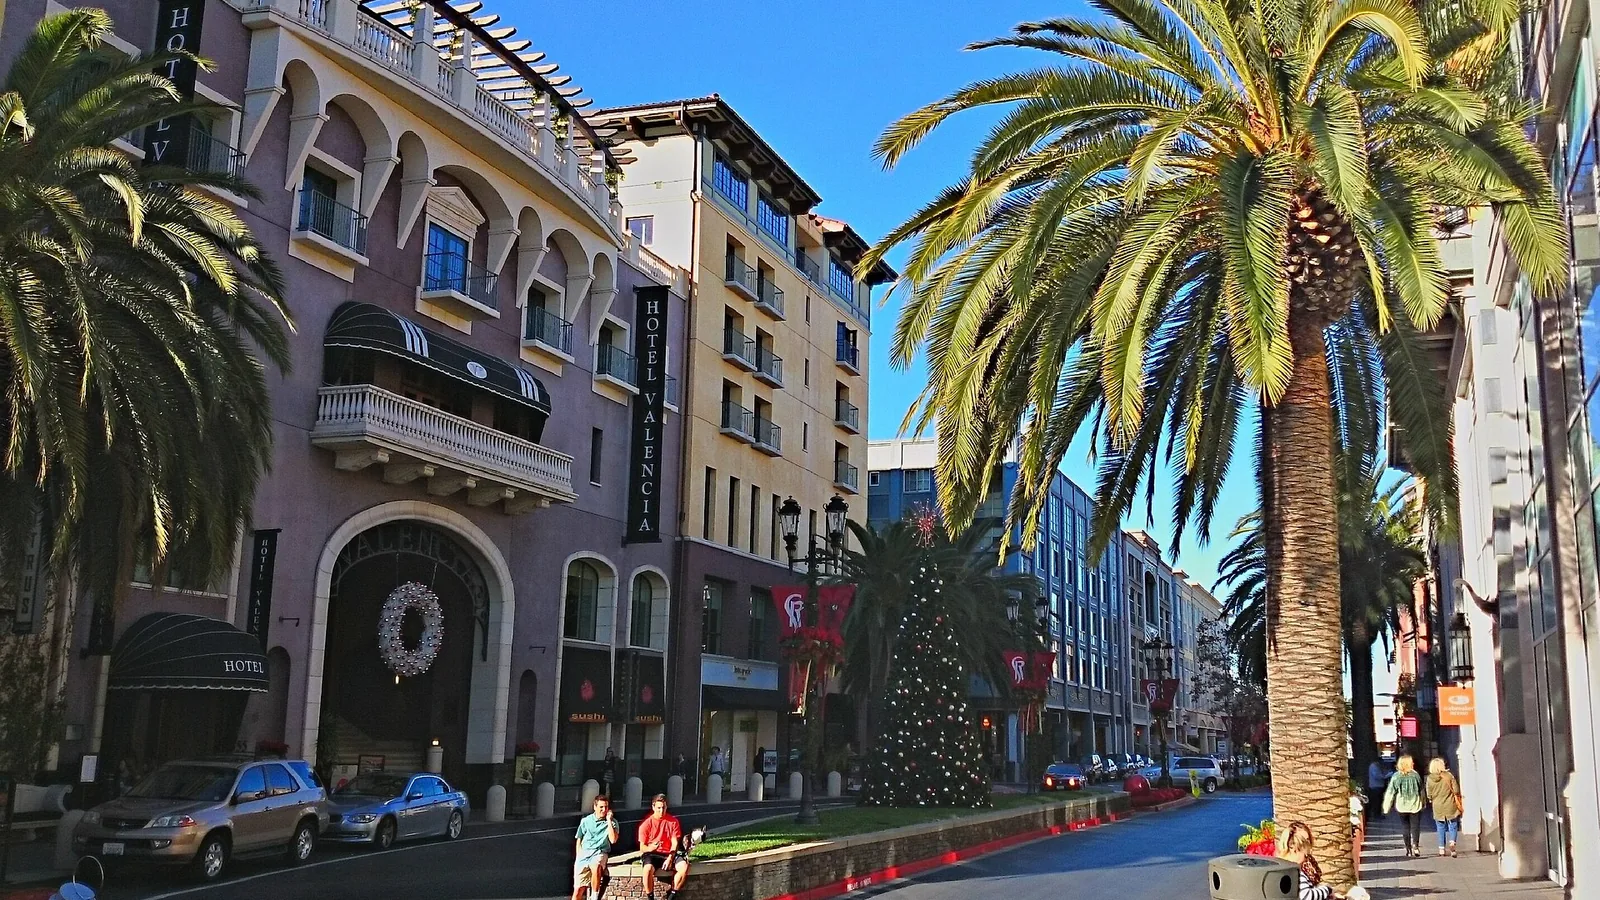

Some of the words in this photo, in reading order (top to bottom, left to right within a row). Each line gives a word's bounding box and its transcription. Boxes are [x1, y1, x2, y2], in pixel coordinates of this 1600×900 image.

[157, 7, 189, 132] HOTL
[646, 301, 659, 382] HOTEL
[639, 392, 656, 532] VALENCIA
[224, 660, 265, 674] HOTEL
[571, 712, 606, 721] sushi
[635, 714, 662, 722] sushi
